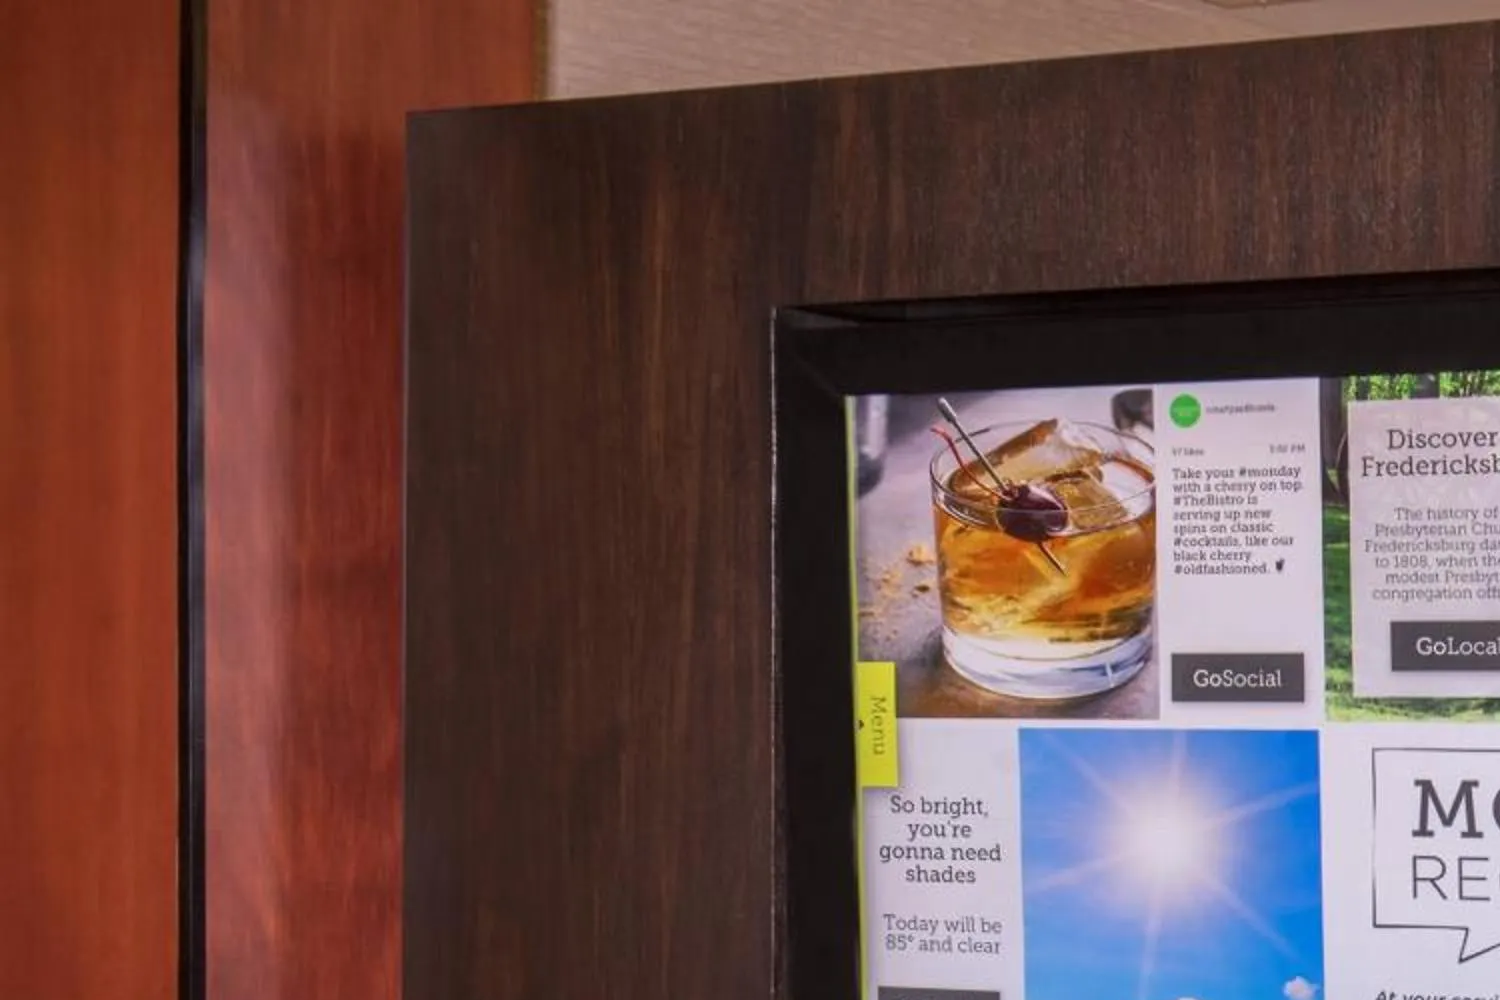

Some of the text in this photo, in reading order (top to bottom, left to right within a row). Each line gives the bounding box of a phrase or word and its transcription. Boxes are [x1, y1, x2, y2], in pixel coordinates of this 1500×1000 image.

[1386, 428, 1498, 451] Discover
[1172, 465, 1301, 481] Take your #monday
[1172, 482, 1201, 492] with
[1204, 484, 1211, 492] a
[1215, 481, 1257, 494] cherry
[1260, 482, 1277, 492] on
[1173, 493, 1258, 507] #TheBistro is
[1172, 509, 1272, 522] serving up new
[1394, 507, 1422, 521] The
[1427, 506, 1479, 522] history
[1483, 506, 1498, 519] of
[1173, 521, 1274, 537] spins on classic
[1375, 522, 1467, 538] Presbyterian
[1173, 536, 1294, 548] #cocktails, like our
[1364, 539, 1475, 555] Fredericksburg
[1173, 549, 1252, 563] black cherry
[1375, 556, 1390, 568] to
[1394, 555, 1431, 570] 1808,
[1435, 555, 1478, 567] when
[1174, 562, 1270, 575] #oldfashioned.
[1385, 571, 1439, 585] modest
[1372, 588, 1472, 602] congregation
[1193, 669, 1282, 689] GoSocial
[870, 697, 887, 756] Menu
[889, 795, 988, 819] So bright,
[907, 820, 972, 841] you're
[879, 843, 1001, 863] gonna need
[905, 865, 976, 883] shades
[883, 913, 1003, 936] Today will be
[885, 933, 1001, 954] 85° and clear
